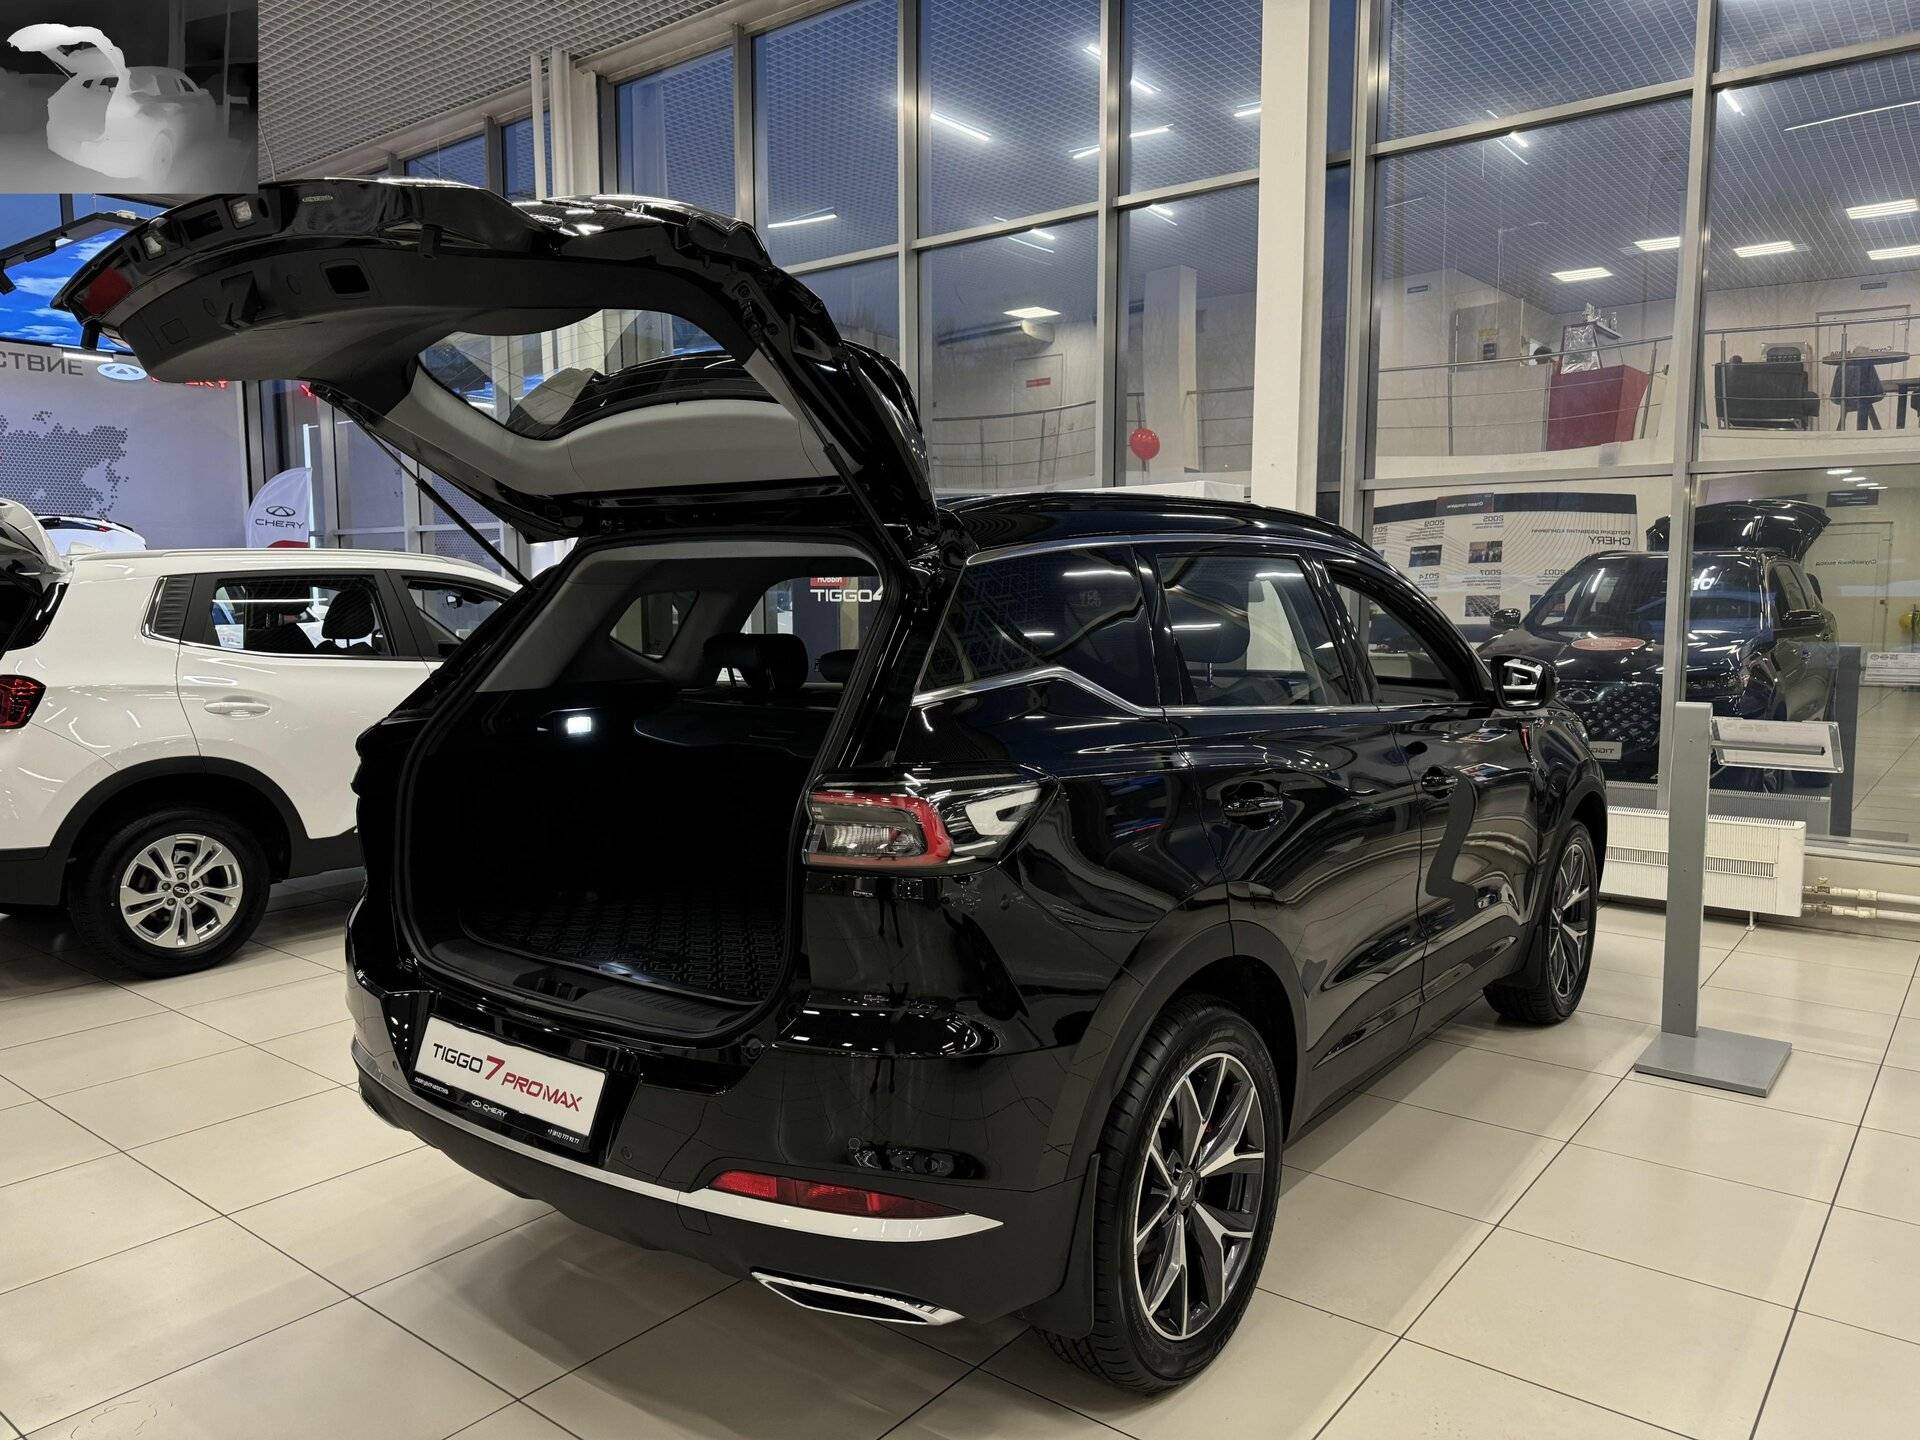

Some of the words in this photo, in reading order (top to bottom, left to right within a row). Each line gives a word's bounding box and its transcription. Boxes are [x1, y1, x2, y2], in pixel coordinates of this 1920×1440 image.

[255, 518, 304, 529] CHERY
[433, 1043, 483, 1073] TIGGO
[485, 1055, 505, 1080] 7
[483, 1104, 508, 1117] CHERY
